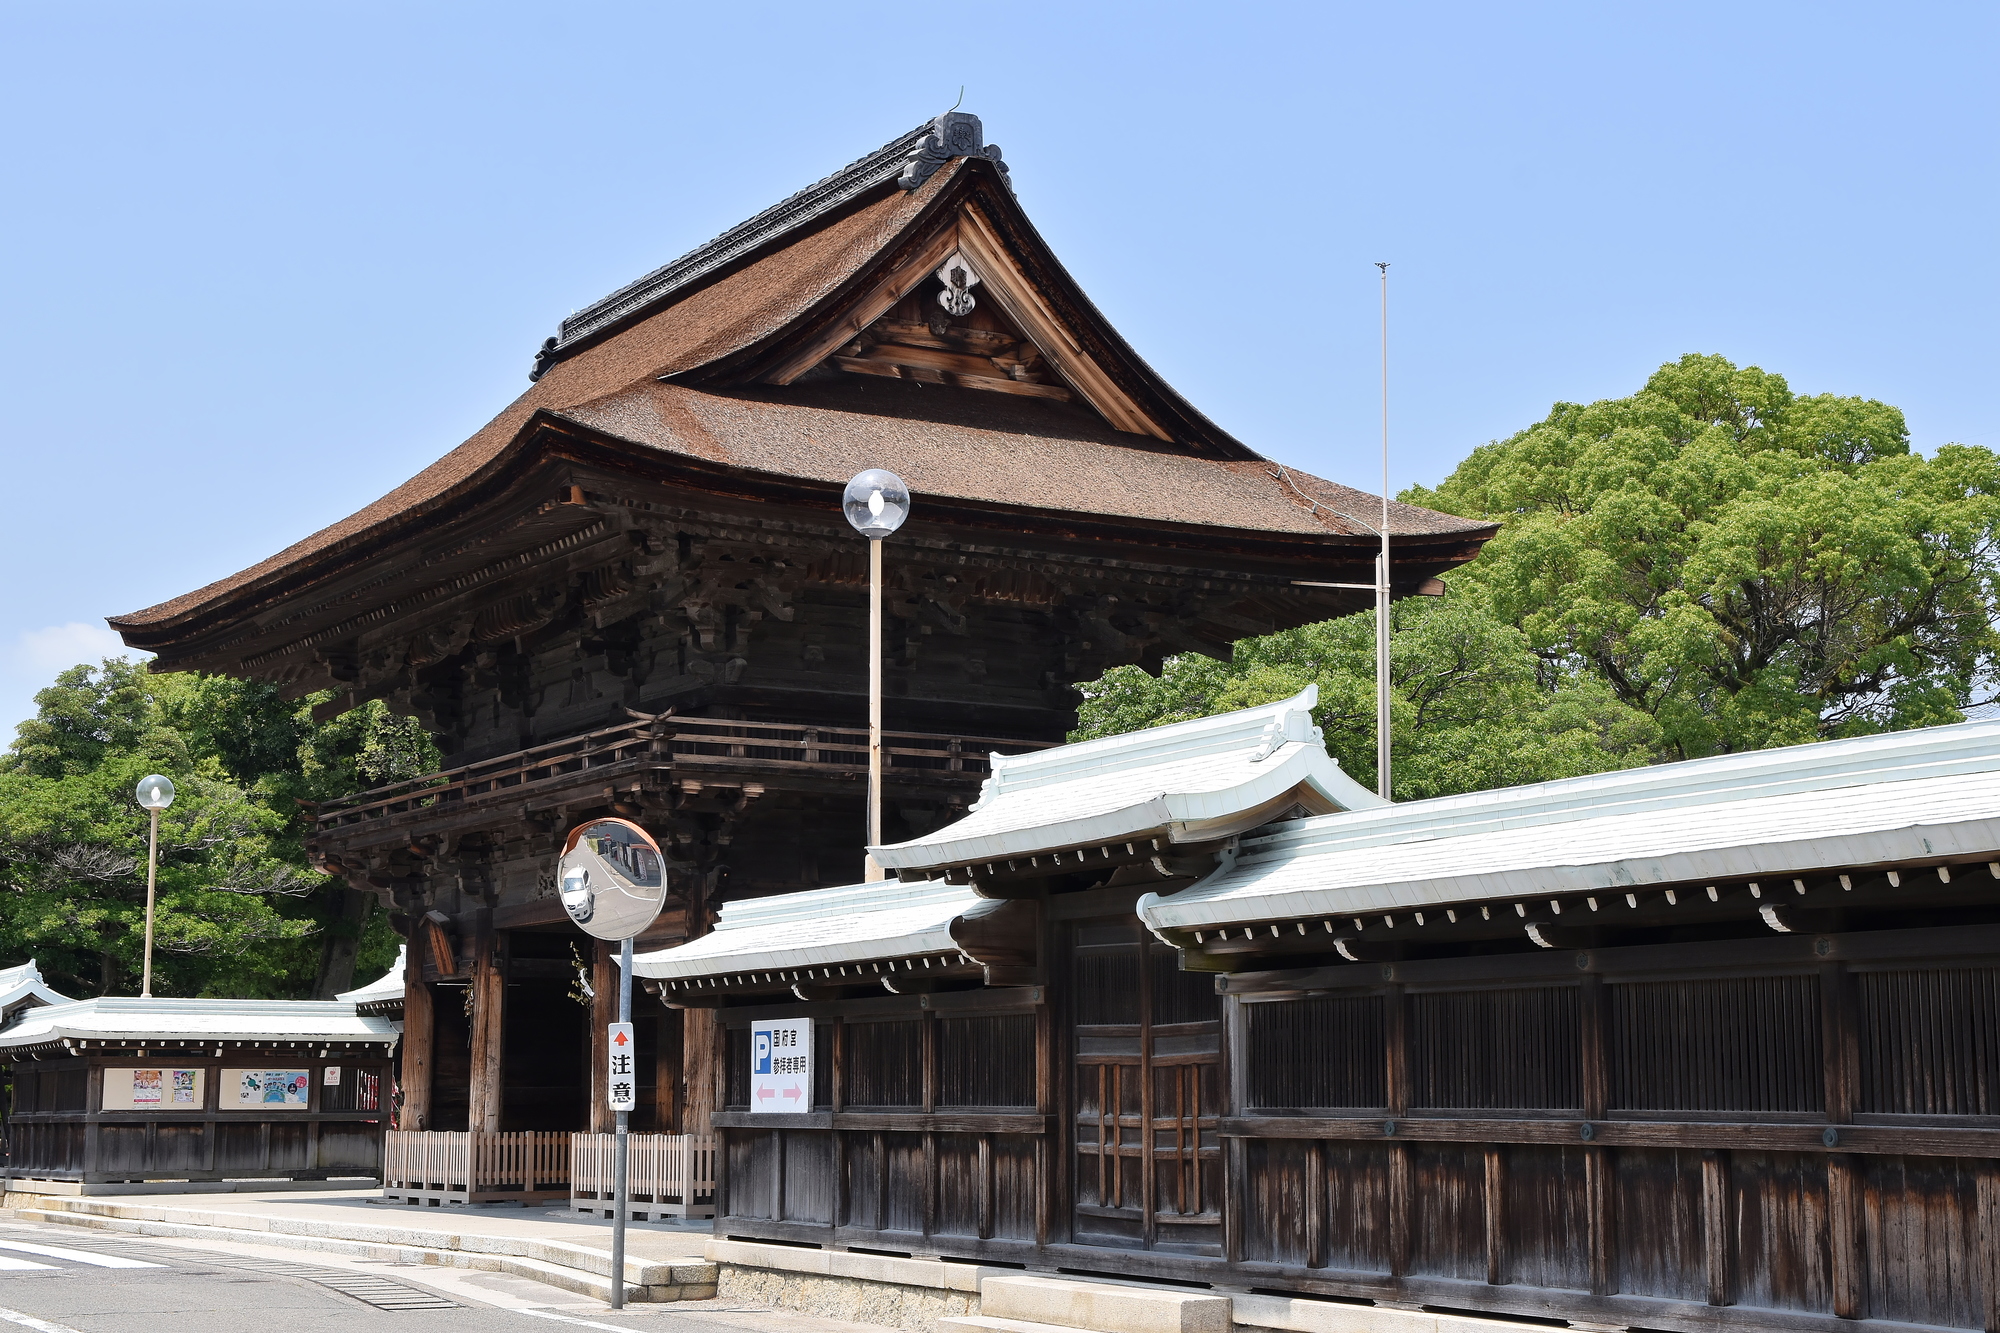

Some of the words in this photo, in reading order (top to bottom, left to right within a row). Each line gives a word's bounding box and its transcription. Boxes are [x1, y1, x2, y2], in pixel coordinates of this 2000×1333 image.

[774, 1029, 797, 1047] 国府宮
[755, 1034, 770, 1071] P
[773, 1056, 806, 1074] 参拝者専用
[612, 1054, 631, 1103] 注意
